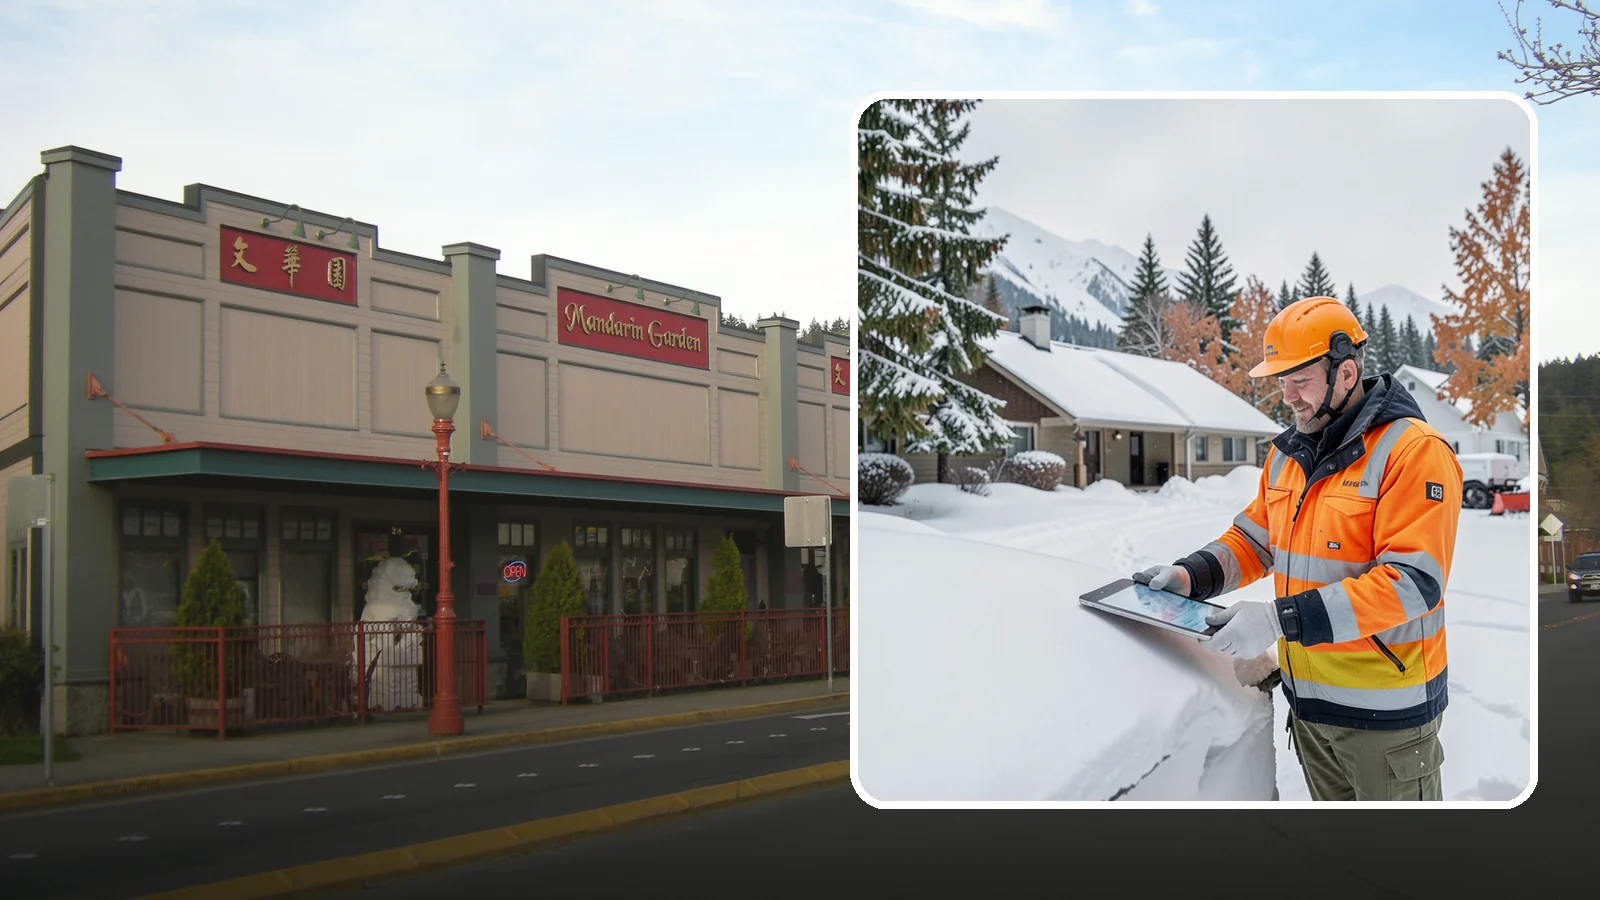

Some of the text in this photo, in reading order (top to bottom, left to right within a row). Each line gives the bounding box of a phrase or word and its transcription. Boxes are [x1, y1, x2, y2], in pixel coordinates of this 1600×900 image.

[231, 236, 346, 291] 文華園
[564, 302, 702, 352] Mandarin Garden
[834, 363, 846, 386] 文
[503, 565, 527, 578] OPEN
